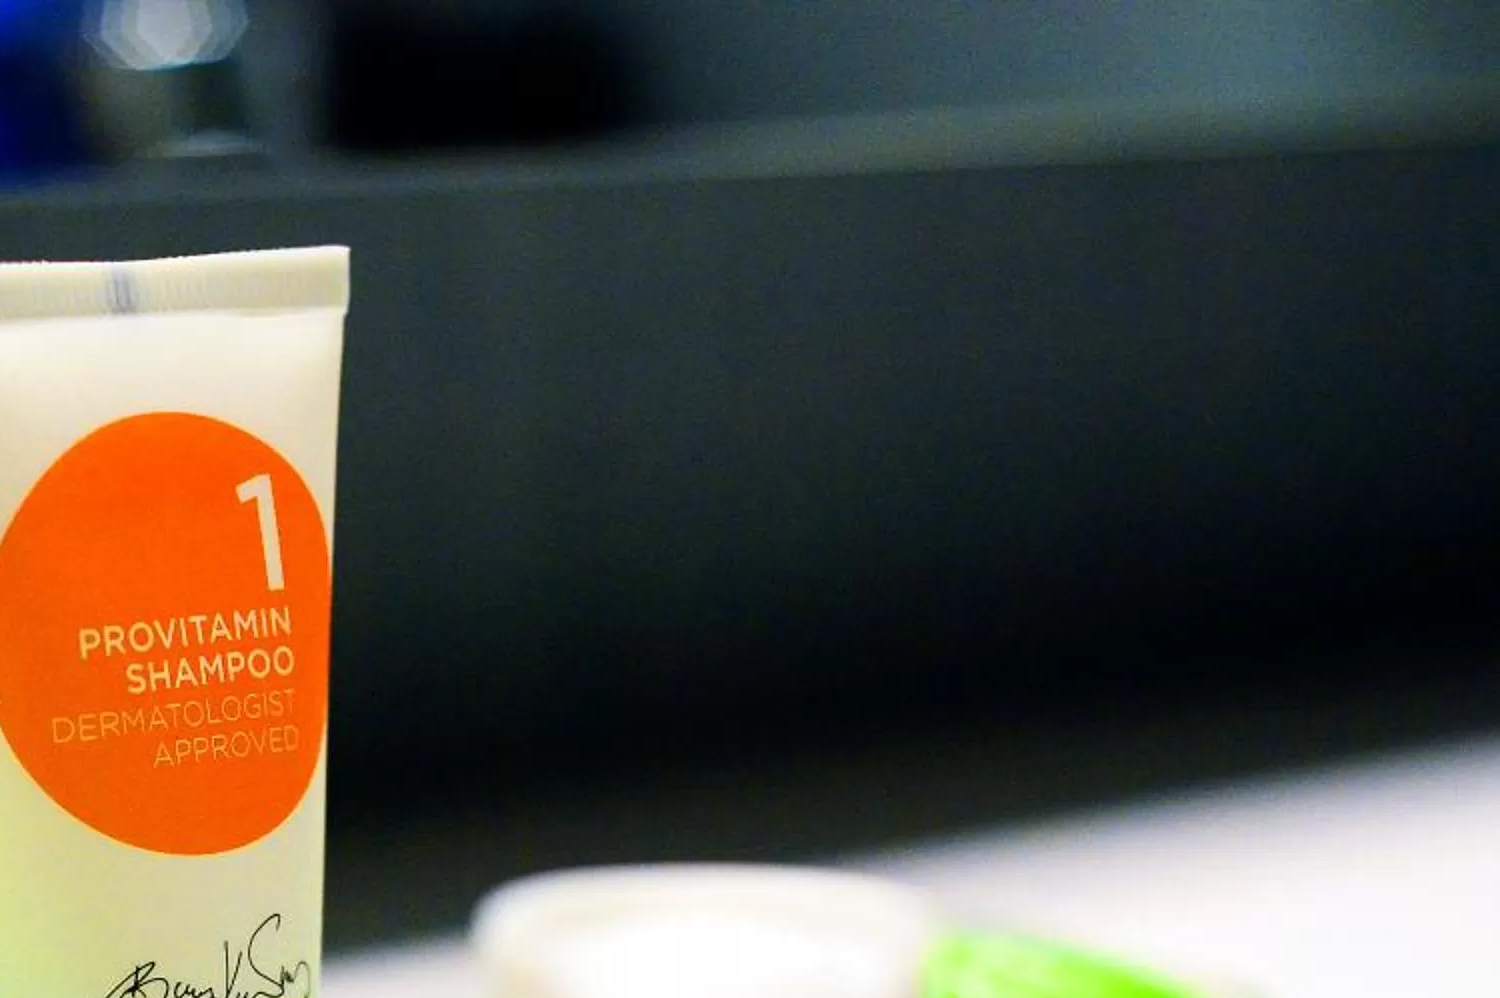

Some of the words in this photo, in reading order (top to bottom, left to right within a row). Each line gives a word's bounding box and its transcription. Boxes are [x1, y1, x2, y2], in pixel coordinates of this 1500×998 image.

[235, 473, 285, 590] 1
[78, 607, 291, 659] PROVITAMIN
[126, 646, 294, 694] SHAMPOO
[51, 689, 295, 743] DERMATOLOGIST
[154, 725, 298, 768] APPROVED
